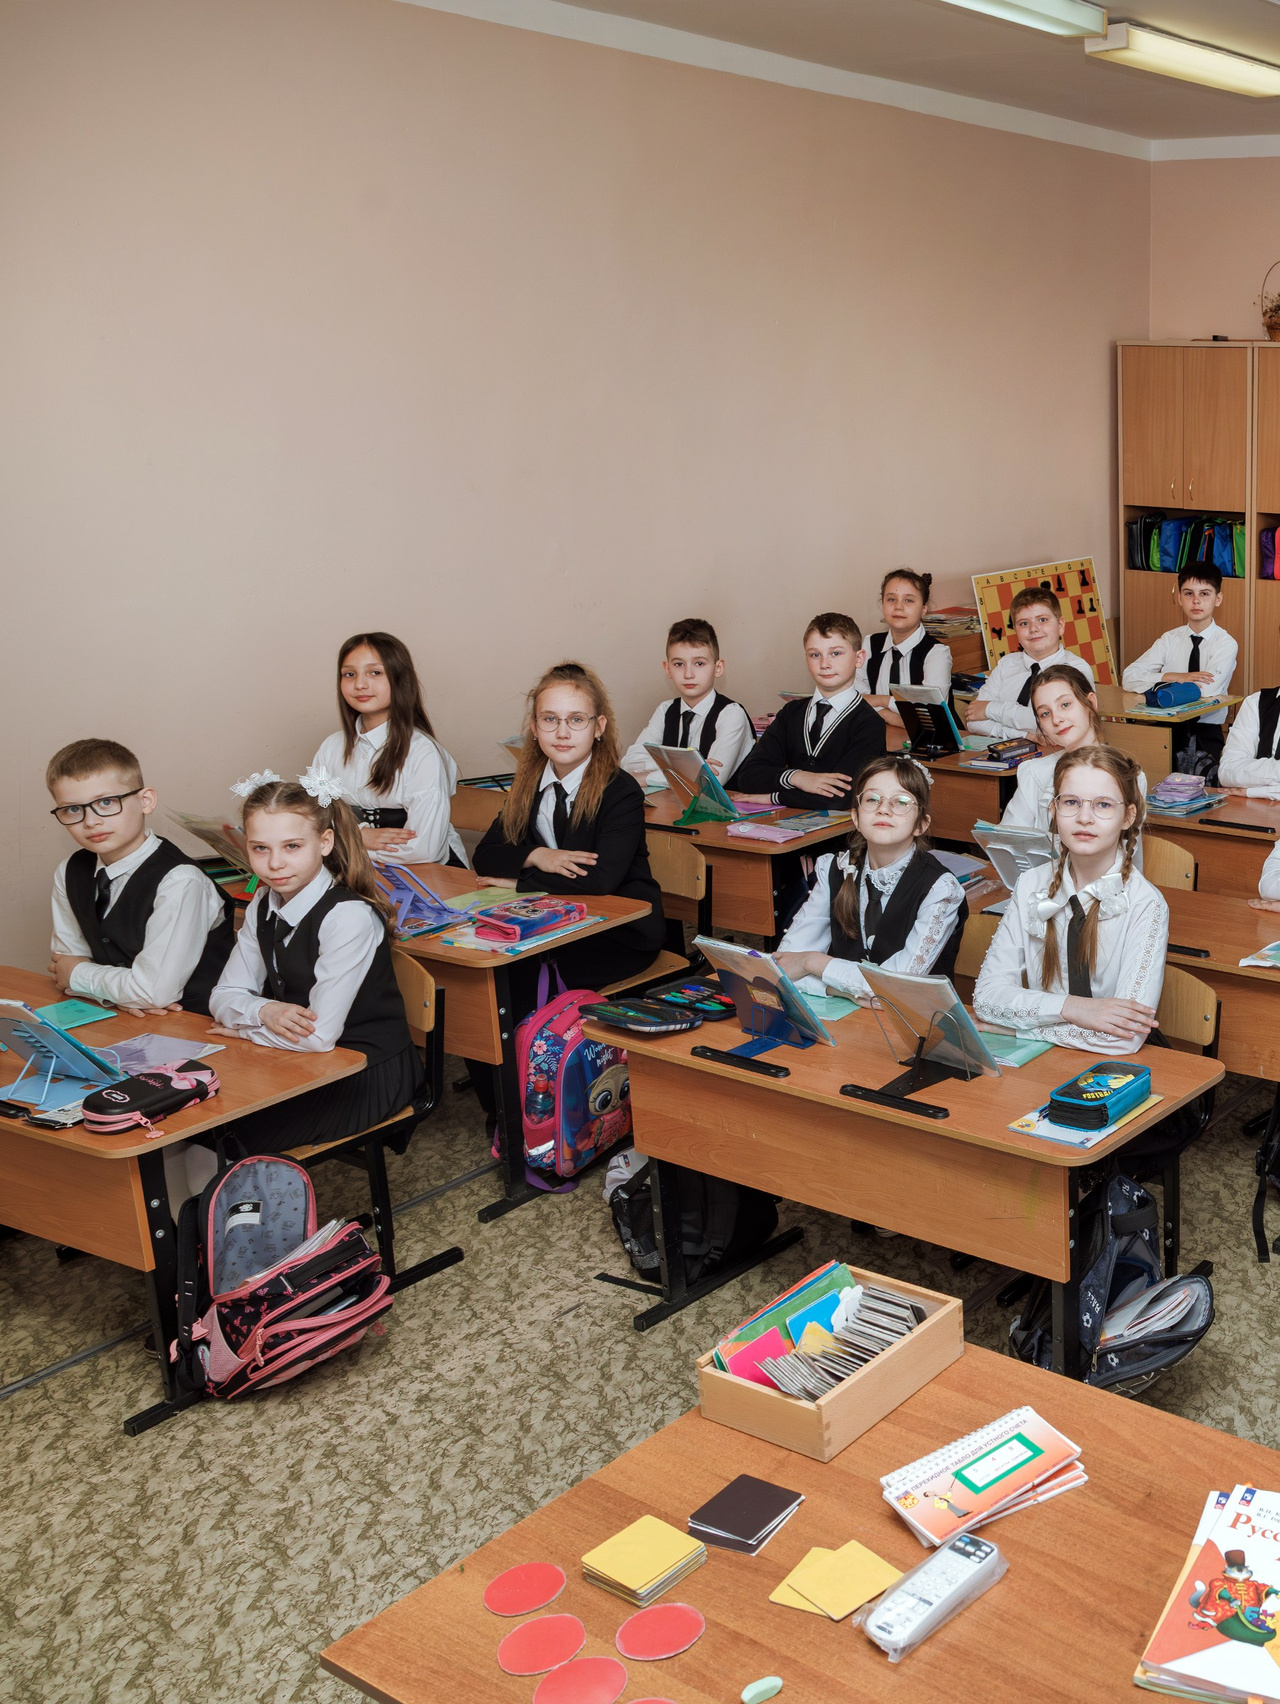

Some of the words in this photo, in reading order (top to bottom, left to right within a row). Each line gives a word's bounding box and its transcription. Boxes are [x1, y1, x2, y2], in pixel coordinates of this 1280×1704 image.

[910, 1466, 951, 1492] ПЕРЕКИДНОЕ
[951, 1453, 971, 1468] ТАБЛО
[970, 1445, 984, 1457] ДЛЯ
[983, 1430, 1010, 1448] УСТНОГО
[1009, 1419, 1028, 1432] СЧЕТА
